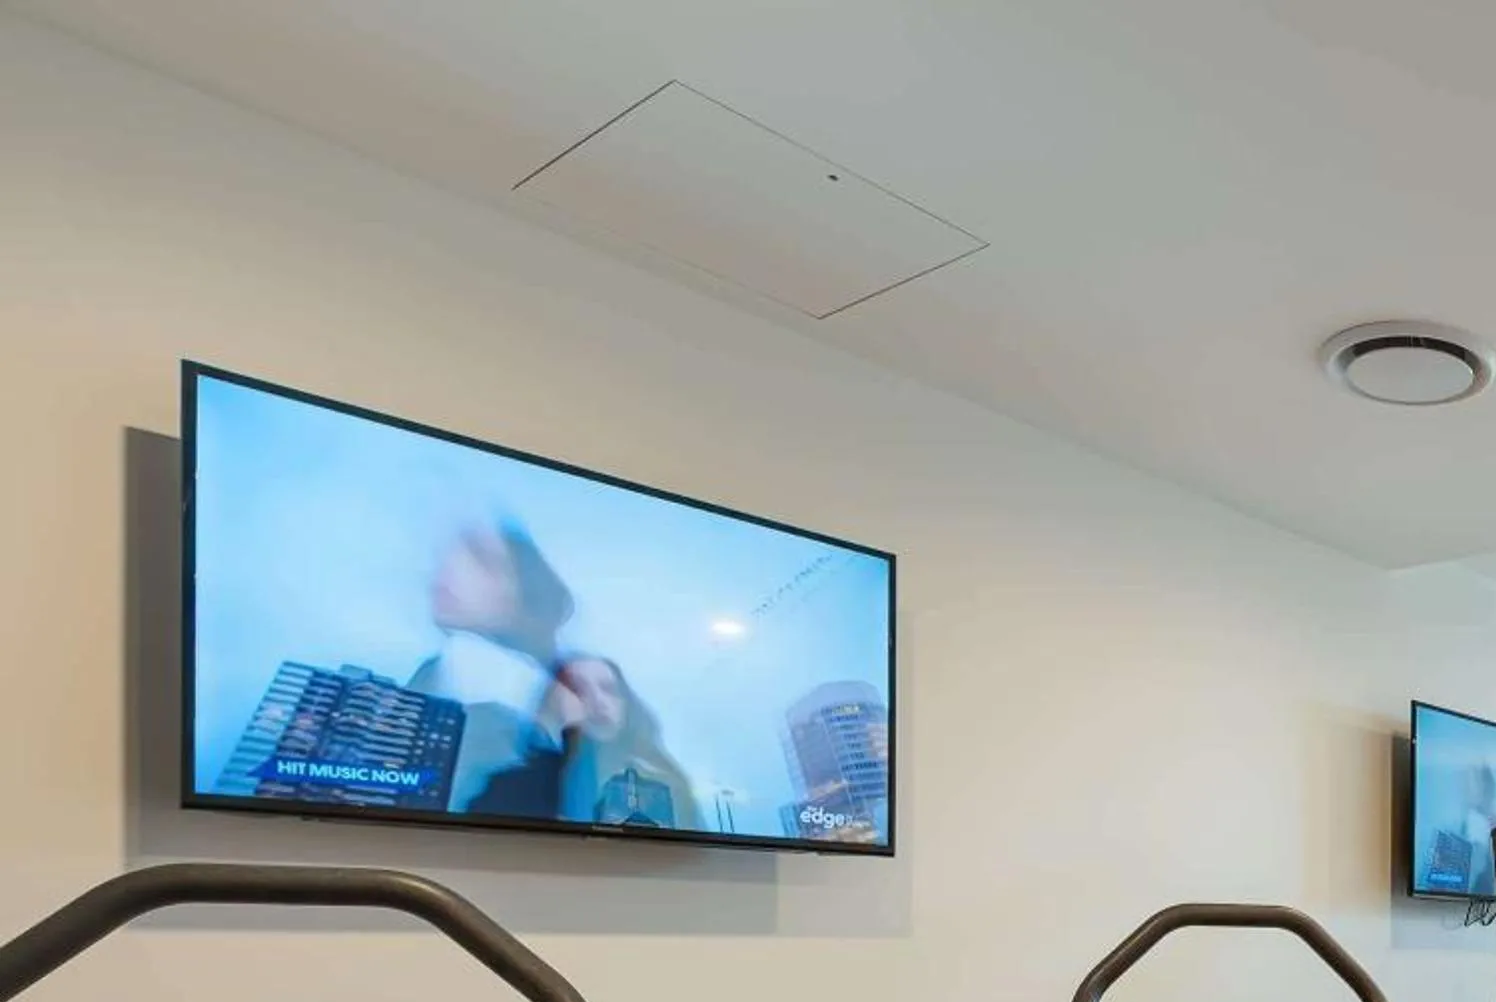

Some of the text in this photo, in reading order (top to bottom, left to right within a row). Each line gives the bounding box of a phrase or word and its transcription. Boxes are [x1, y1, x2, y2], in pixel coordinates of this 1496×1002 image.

[276, 759, 420, 785] HIT MUSIC NOW
[800, 806, 845, 829] edge
